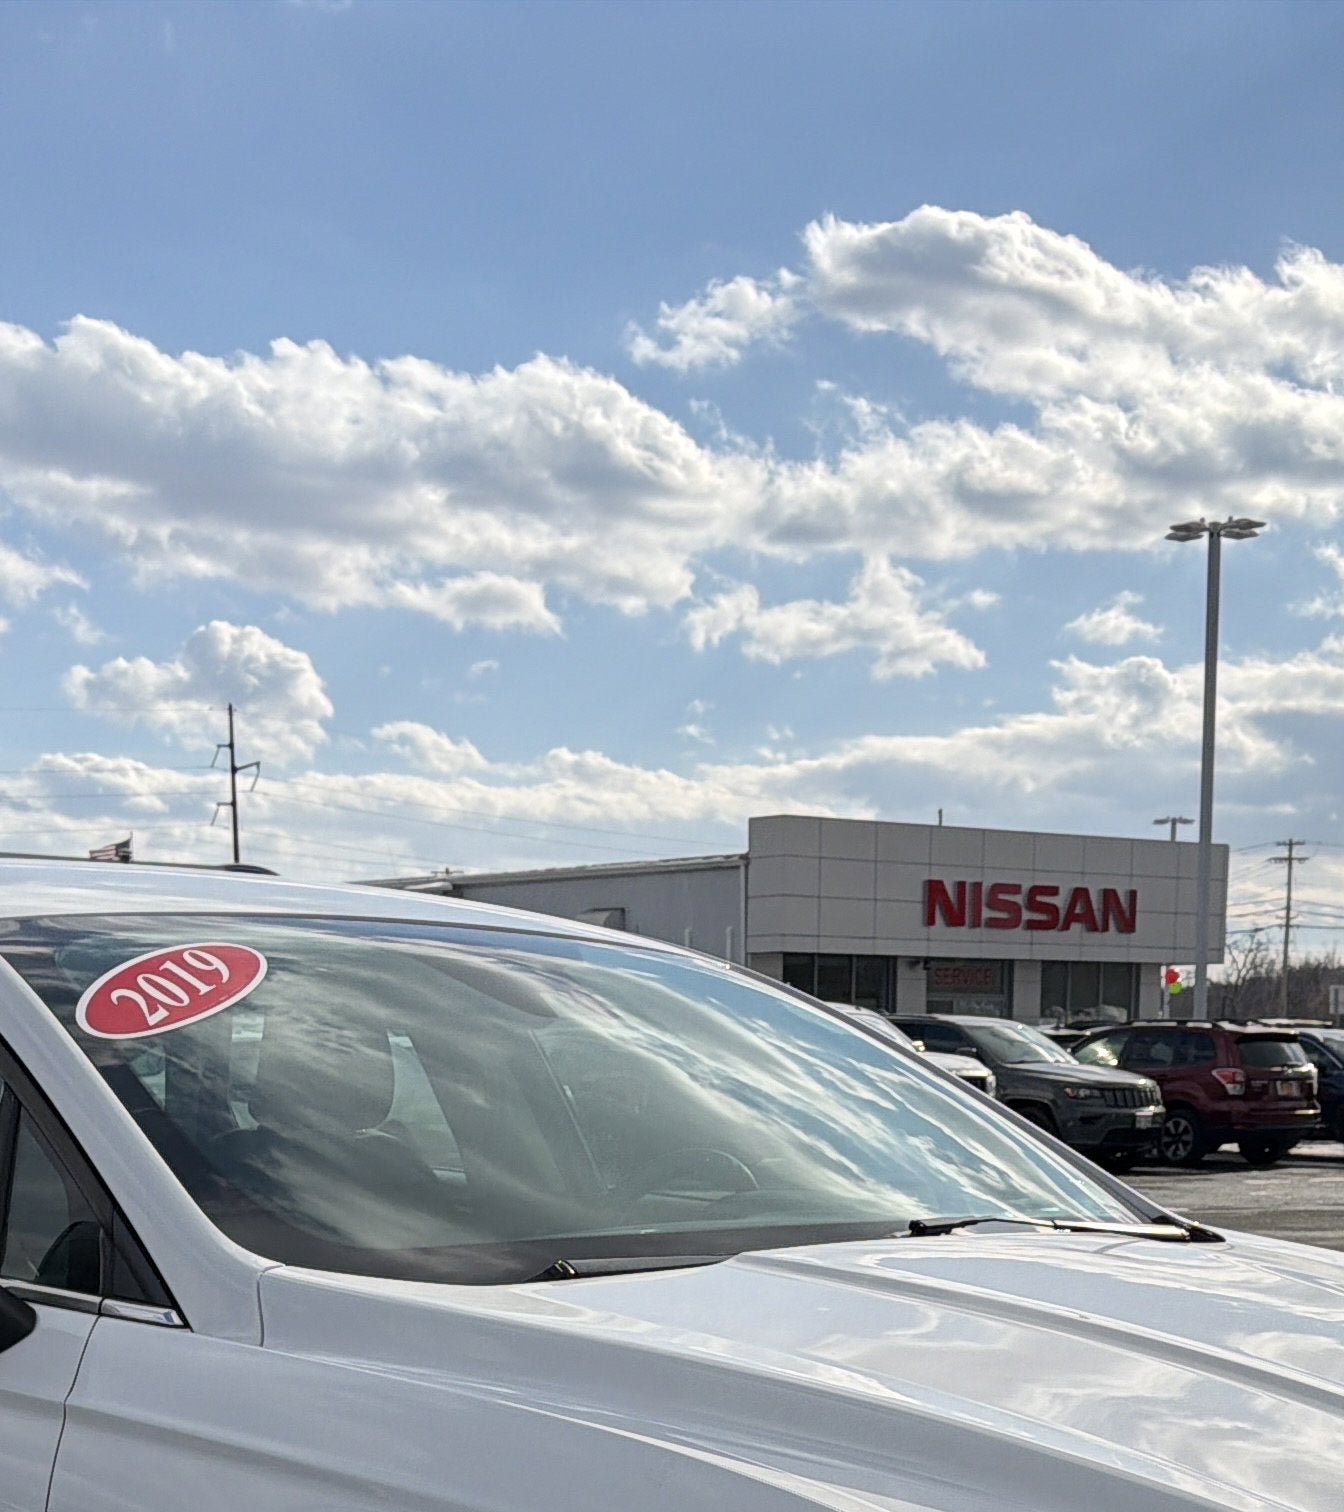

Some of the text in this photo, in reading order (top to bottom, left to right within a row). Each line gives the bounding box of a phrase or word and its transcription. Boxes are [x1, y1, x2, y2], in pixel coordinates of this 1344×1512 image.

[923, 879, 1138, 934] NISSAN
[110, 949, 230, 1027] 2019
[935, 967, 993, 985] SERVICE
